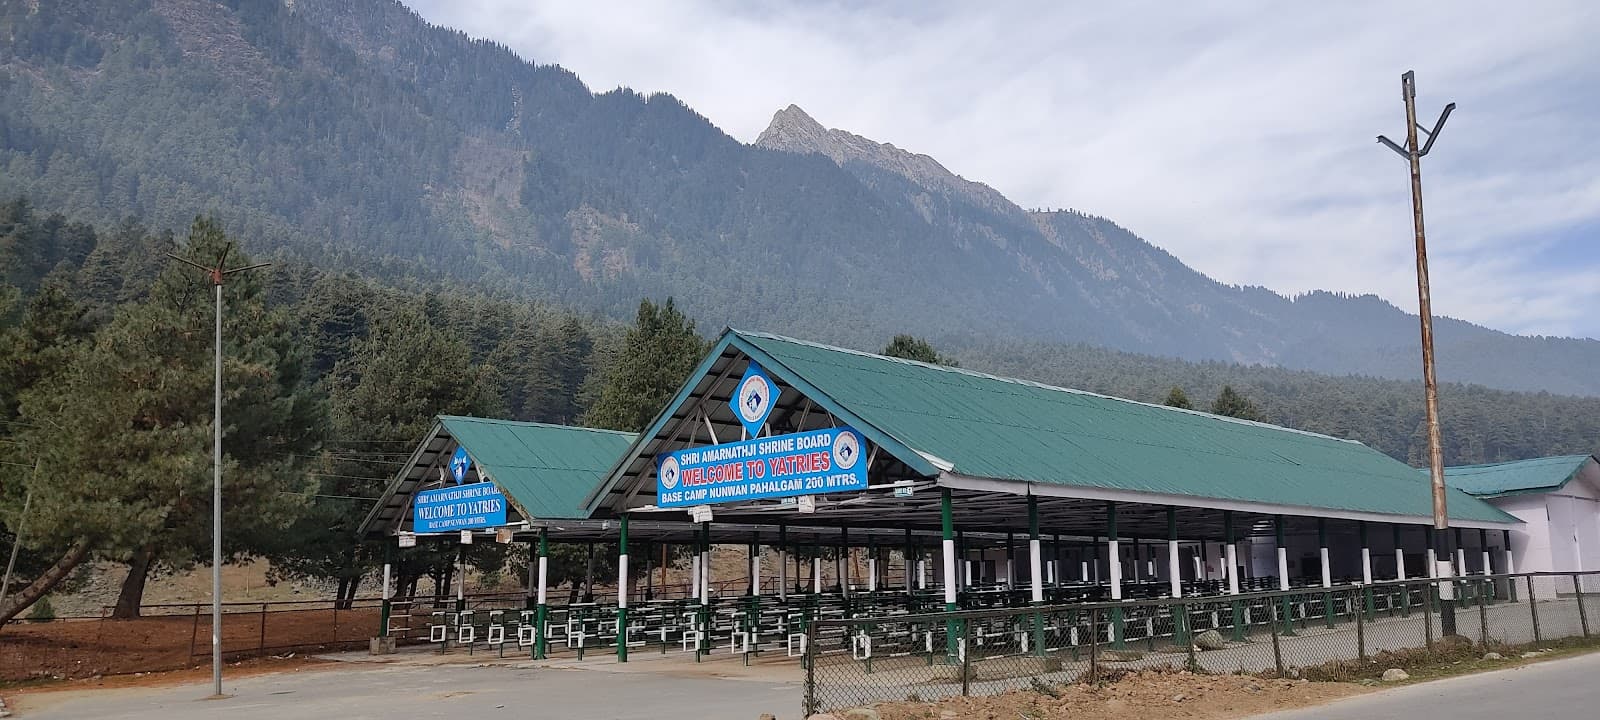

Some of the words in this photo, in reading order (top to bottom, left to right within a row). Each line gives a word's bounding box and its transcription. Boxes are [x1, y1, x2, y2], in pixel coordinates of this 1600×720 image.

[680, 451, 699, 466] SHRI
[701, 444, 757, 463] AMARNATHJI
[759, 439, 794, 456] SHRINE
[797, 434, 831, 450] BOARD
[681, 462, 744, 487] WELCOME
[747, 459, 765, 479] TO
[770, 451, 831, 477] YATRIES
[462, 488, 482, 498] SHRINE
[661, 490, 683, 503] BASE
[684, 487, 707, 501] CAMP
[709, 484, 748, 498] NUNWAN
[750, 477, 803, 494] PAHALGAM
[805, 475, 824, 490] 200
[826, 473, 860, 487] MTRS.
[418, 504, 455, 520] WELCOME
[456, 502, 467, 516] TO
[468, 498, 501, 515] YATRIES
